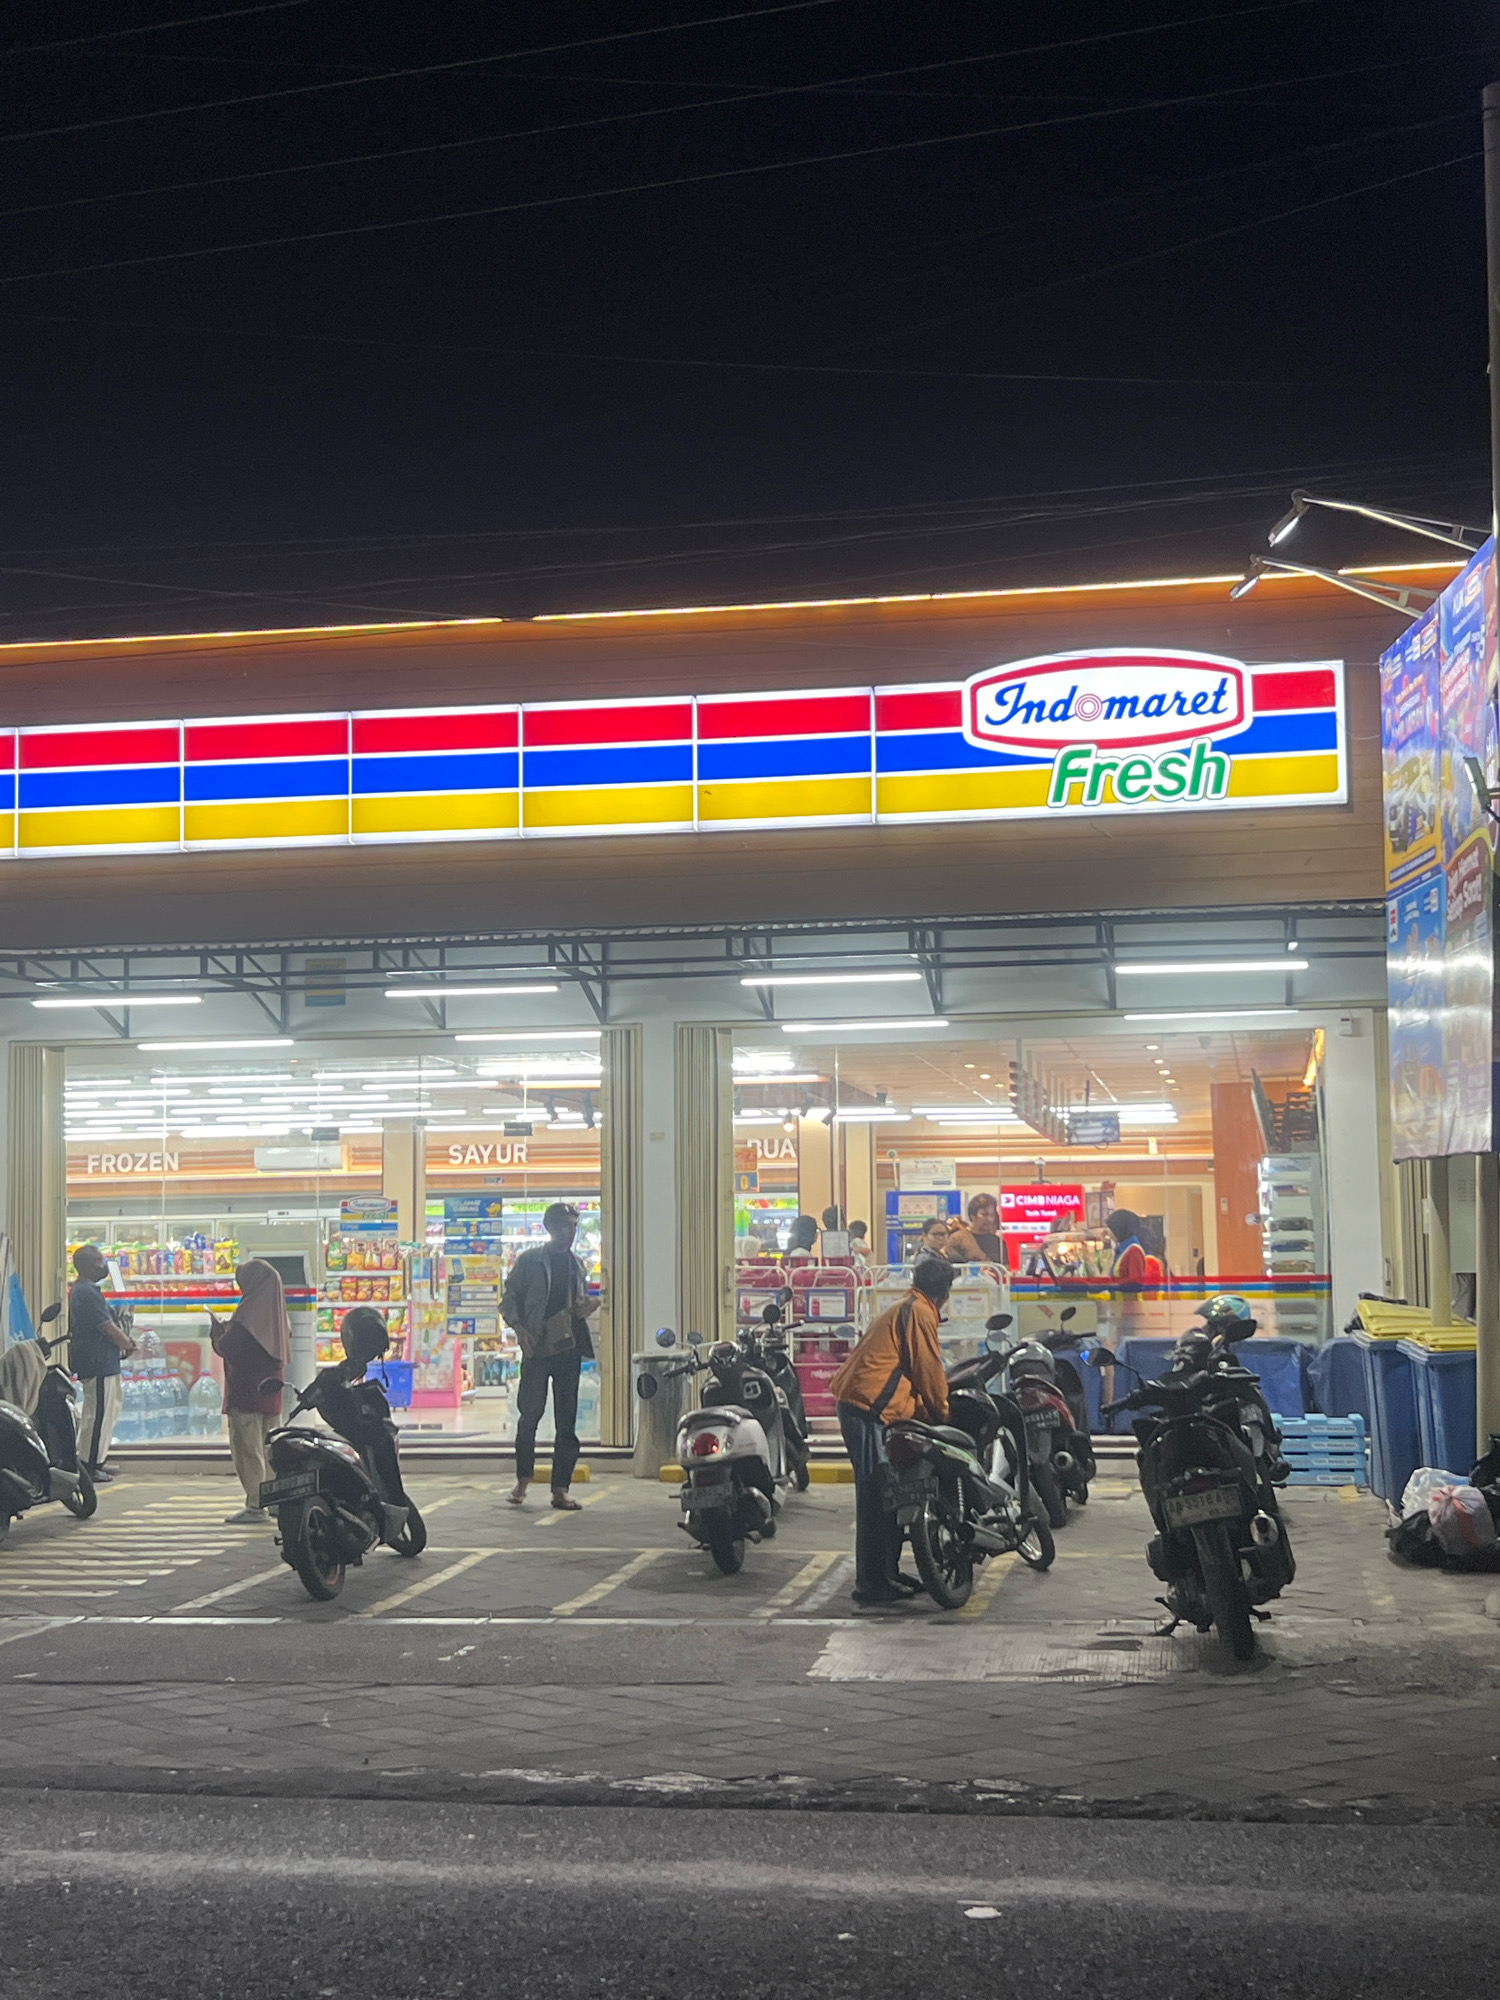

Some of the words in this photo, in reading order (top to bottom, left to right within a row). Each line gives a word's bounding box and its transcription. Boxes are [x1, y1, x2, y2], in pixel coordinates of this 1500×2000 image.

[985, 677, 1229, 725] Indomaret
[1050, 740, 1227, 803] Fresh
[87, 1151, 180, 1174] FROZEN
[448, 1143, 528, 1165] SAYUR
[1045, 1194, 1080, 1205] NIAGA
